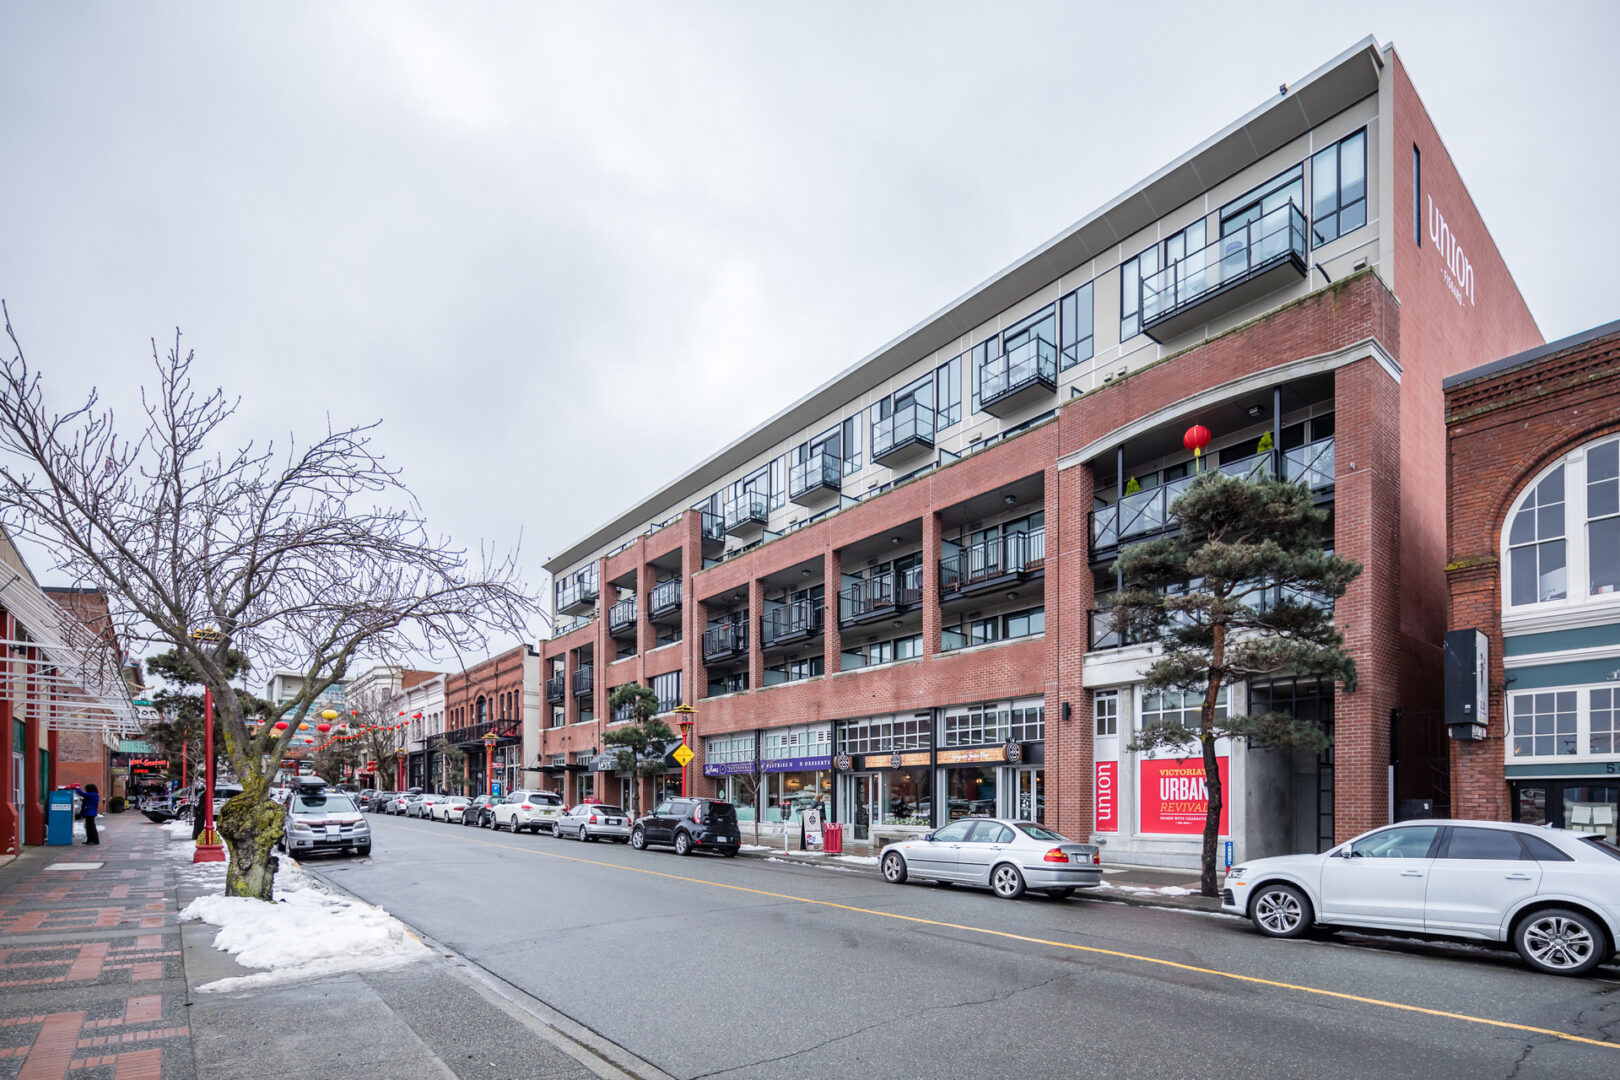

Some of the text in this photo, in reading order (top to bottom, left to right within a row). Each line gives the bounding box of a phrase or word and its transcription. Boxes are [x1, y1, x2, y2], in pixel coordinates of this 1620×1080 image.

[1427, 193, 1475, 307] union
[1098, 764, 1111, 820] union
[1160, 777, 1209, 800] URBAN
[1160, 802, 1208, 812] REVIVAL
